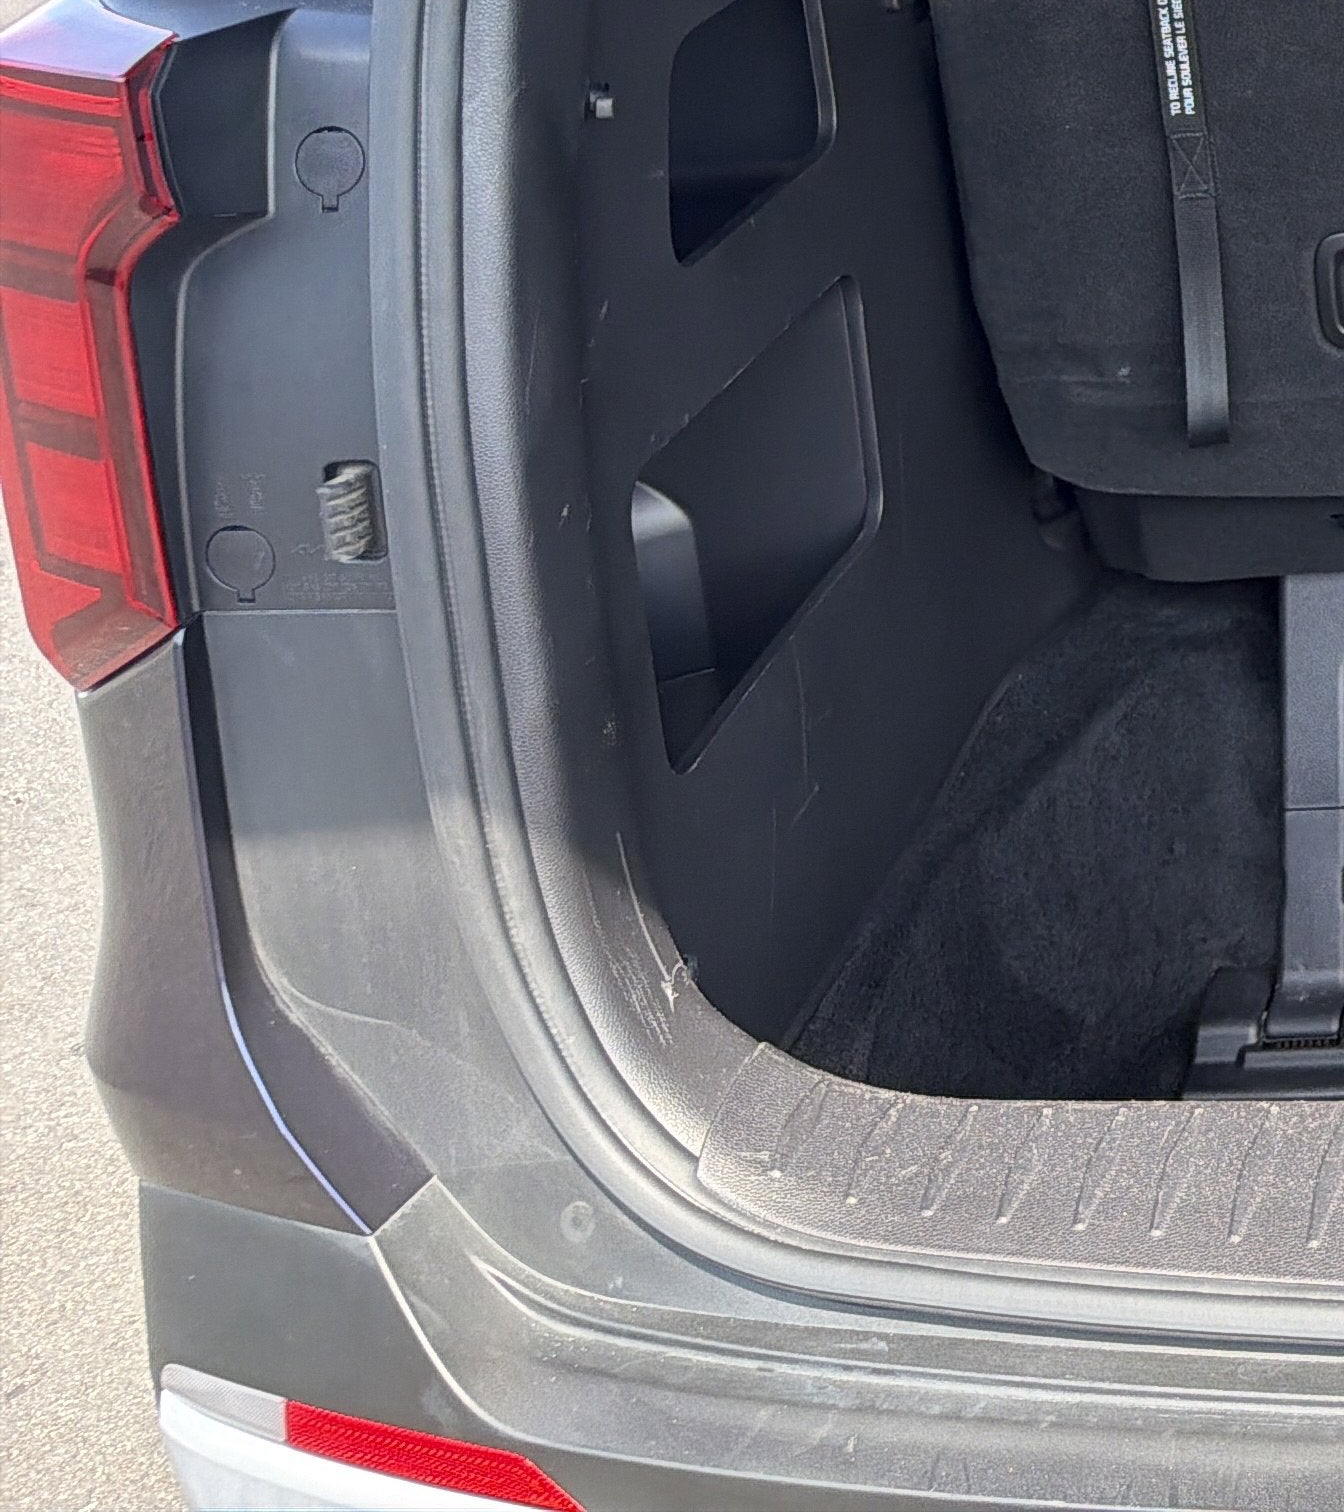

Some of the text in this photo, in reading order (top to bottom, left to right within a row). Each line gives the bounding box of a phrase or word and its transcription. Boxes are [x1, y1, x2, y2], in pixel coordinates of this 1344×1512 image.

[1157, 7, 1176, 58] SEATBACK
[1175, 20, 1186, 35] LE
[1177, 36, 1193, 83] SOULEVER
[1166, 60, 1181, 99] RECLINE
[1170, 100, 1182, 116] TO
[1183, 84, 1196, 116] POUR
